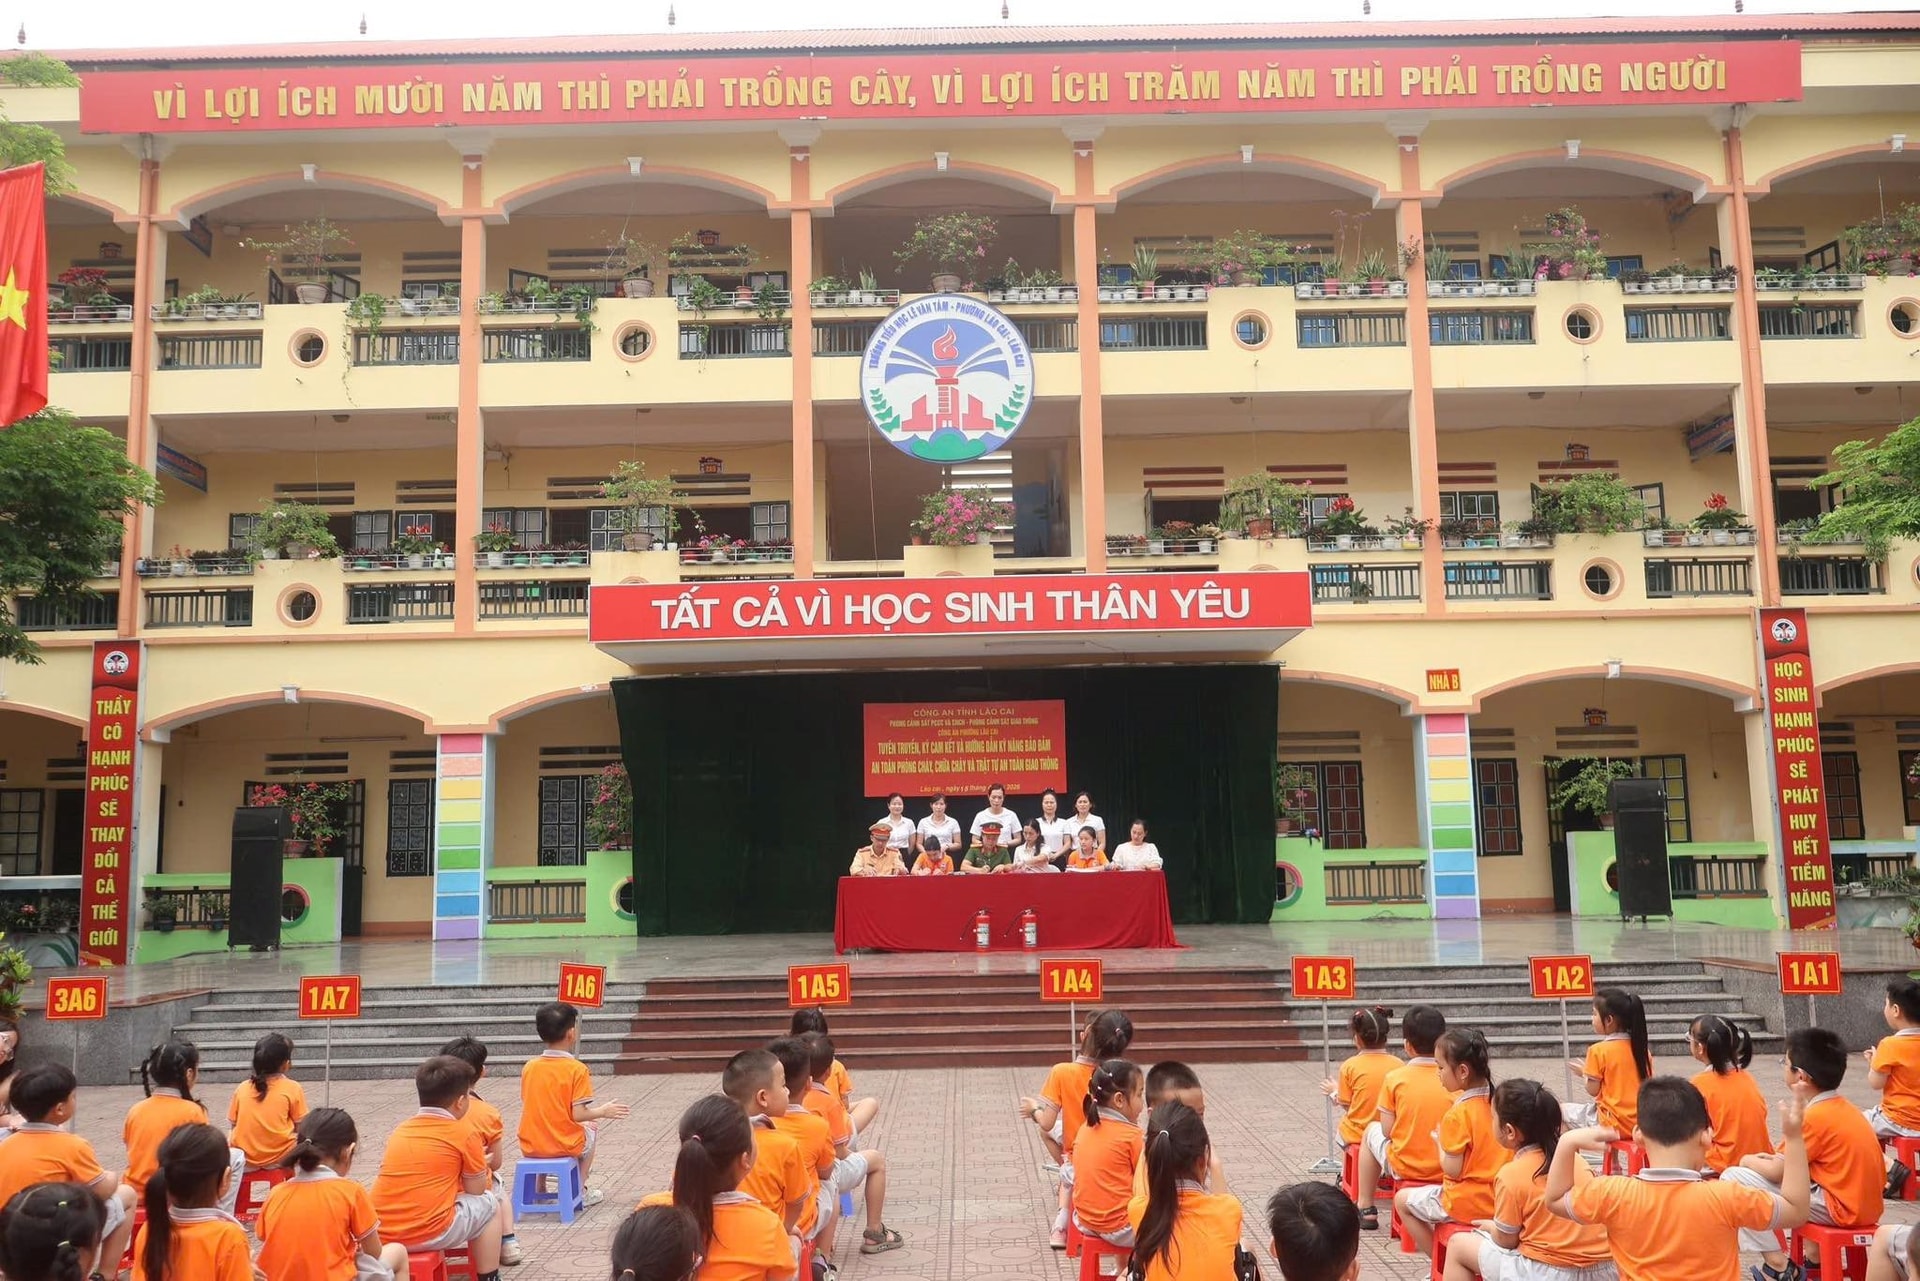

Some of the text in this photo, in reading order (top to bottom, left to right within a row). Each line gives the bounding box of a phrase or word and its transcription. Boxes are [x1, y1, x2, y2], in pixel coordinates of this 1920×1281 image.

[153, 53, 1727, 124] VÌ LỢI ÍCH MƯỜI NĂM THÌ PHẢI TRỒNG CÂY, VÌ LỢI ÍCH TRĂM NĂM THÌ PHẢI TRỒNG NGƯỜI
[894, 314, 909, 329] HỌC
[908, 307, 918, 319] LÊ
[917, 302, 932, 315] VĂN
[933, 299, 949, 312] TÂM
[956, 302, 986, 320] PHƯỜNG
[651, 581, 1249, 632] TẤT CẢ VÌ HỌC SINH THÂN YÊU
[1774, 661, 1803, 680] HỌC
[1452, 674, 1459, 689] B
[96, 694, 132, 715] THẦY
[1774, 687, 1809, 703] SINH
[913, 708, 939, 717] CÔNG
[980, 707, 998, 716] LÀO
[1774, 712, 1814, 731] HẠNH
[102, 724, 123, 741] CÔ
[1777, 735, 1815, 753] PHÚC
[91, 751, 131, 768] HẠNH
[872, 761, 880, 774] AN
[1789, 761, 1808, 779] SẼ
[91, 773, 130, 791] PHÚC
[1782, 786, 1819, 804] PHÁT
[99, 800, 119, 818] SẼ
[1789, 814, 1818, 830] HUY
[90, 827, 126, 843] THAY
[1792, 834, 1819, 856] HẾT
[94, 848, 119, 868] ĐỔI
[1791, 860, 1826, 881] TIỀM
[95, 874, 116, 894] CẢ
[1790, 889, 1832, 908] NĂNG
[91, 899, 118, 920] THẾ
[88, 930, 119, 946] GIỚI
[1049, 968, 1093, 993] 1A4
[1303, 965, 1347, 990] 1A3
[1541, 965, 1586, 990] 1A2
[1789, 961, 1830, 986] 1A1
[566, 973, 596, 999] 1A6
[797, 973, 840, 999] 1A5
[55, 988, 97, 1012] 3A6
[308, 986, 350, 1011] 1A7
